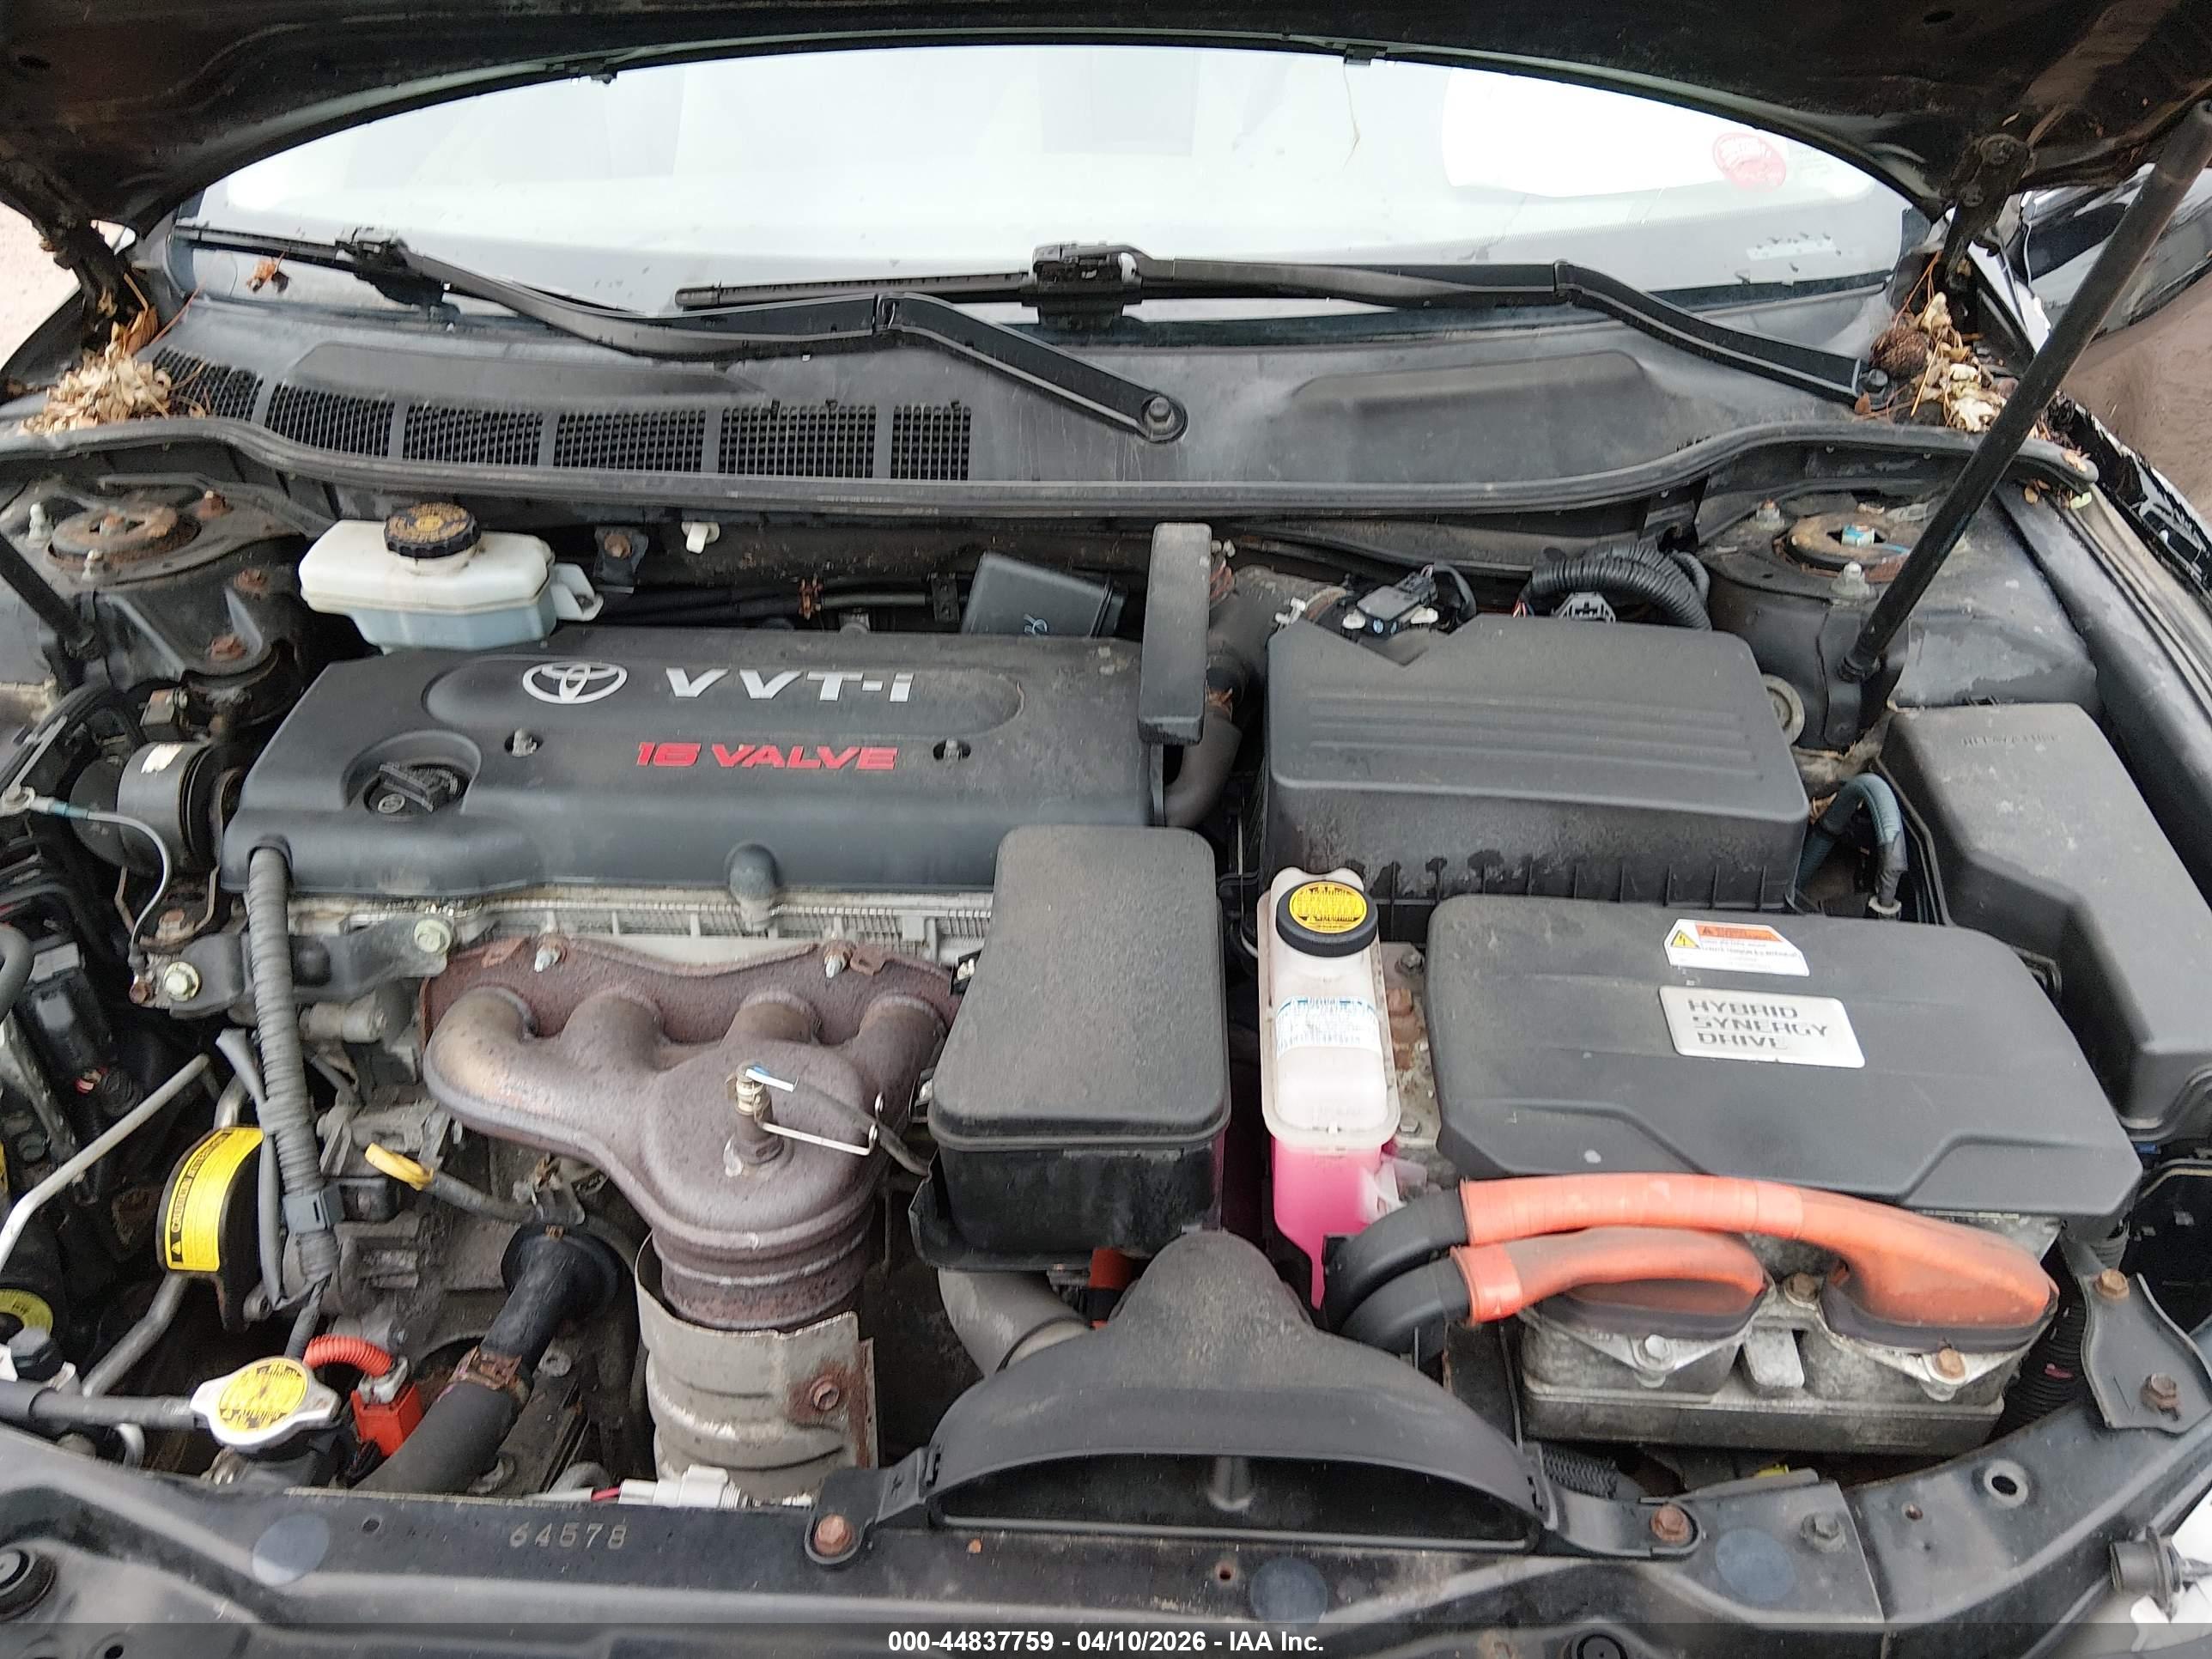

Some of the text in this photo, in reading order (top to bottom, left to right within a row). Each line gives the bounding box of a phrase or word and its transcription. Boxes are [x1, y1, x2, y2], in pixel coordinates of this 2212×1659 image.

[636, 742, 899, 769] 16 VALVE
[1687, 998, 1799, 1019] HYBRID
[1692, 1015, 1829, 1038] SYNERGY
[1696, 1031, 1789, 1050] DRIVE
